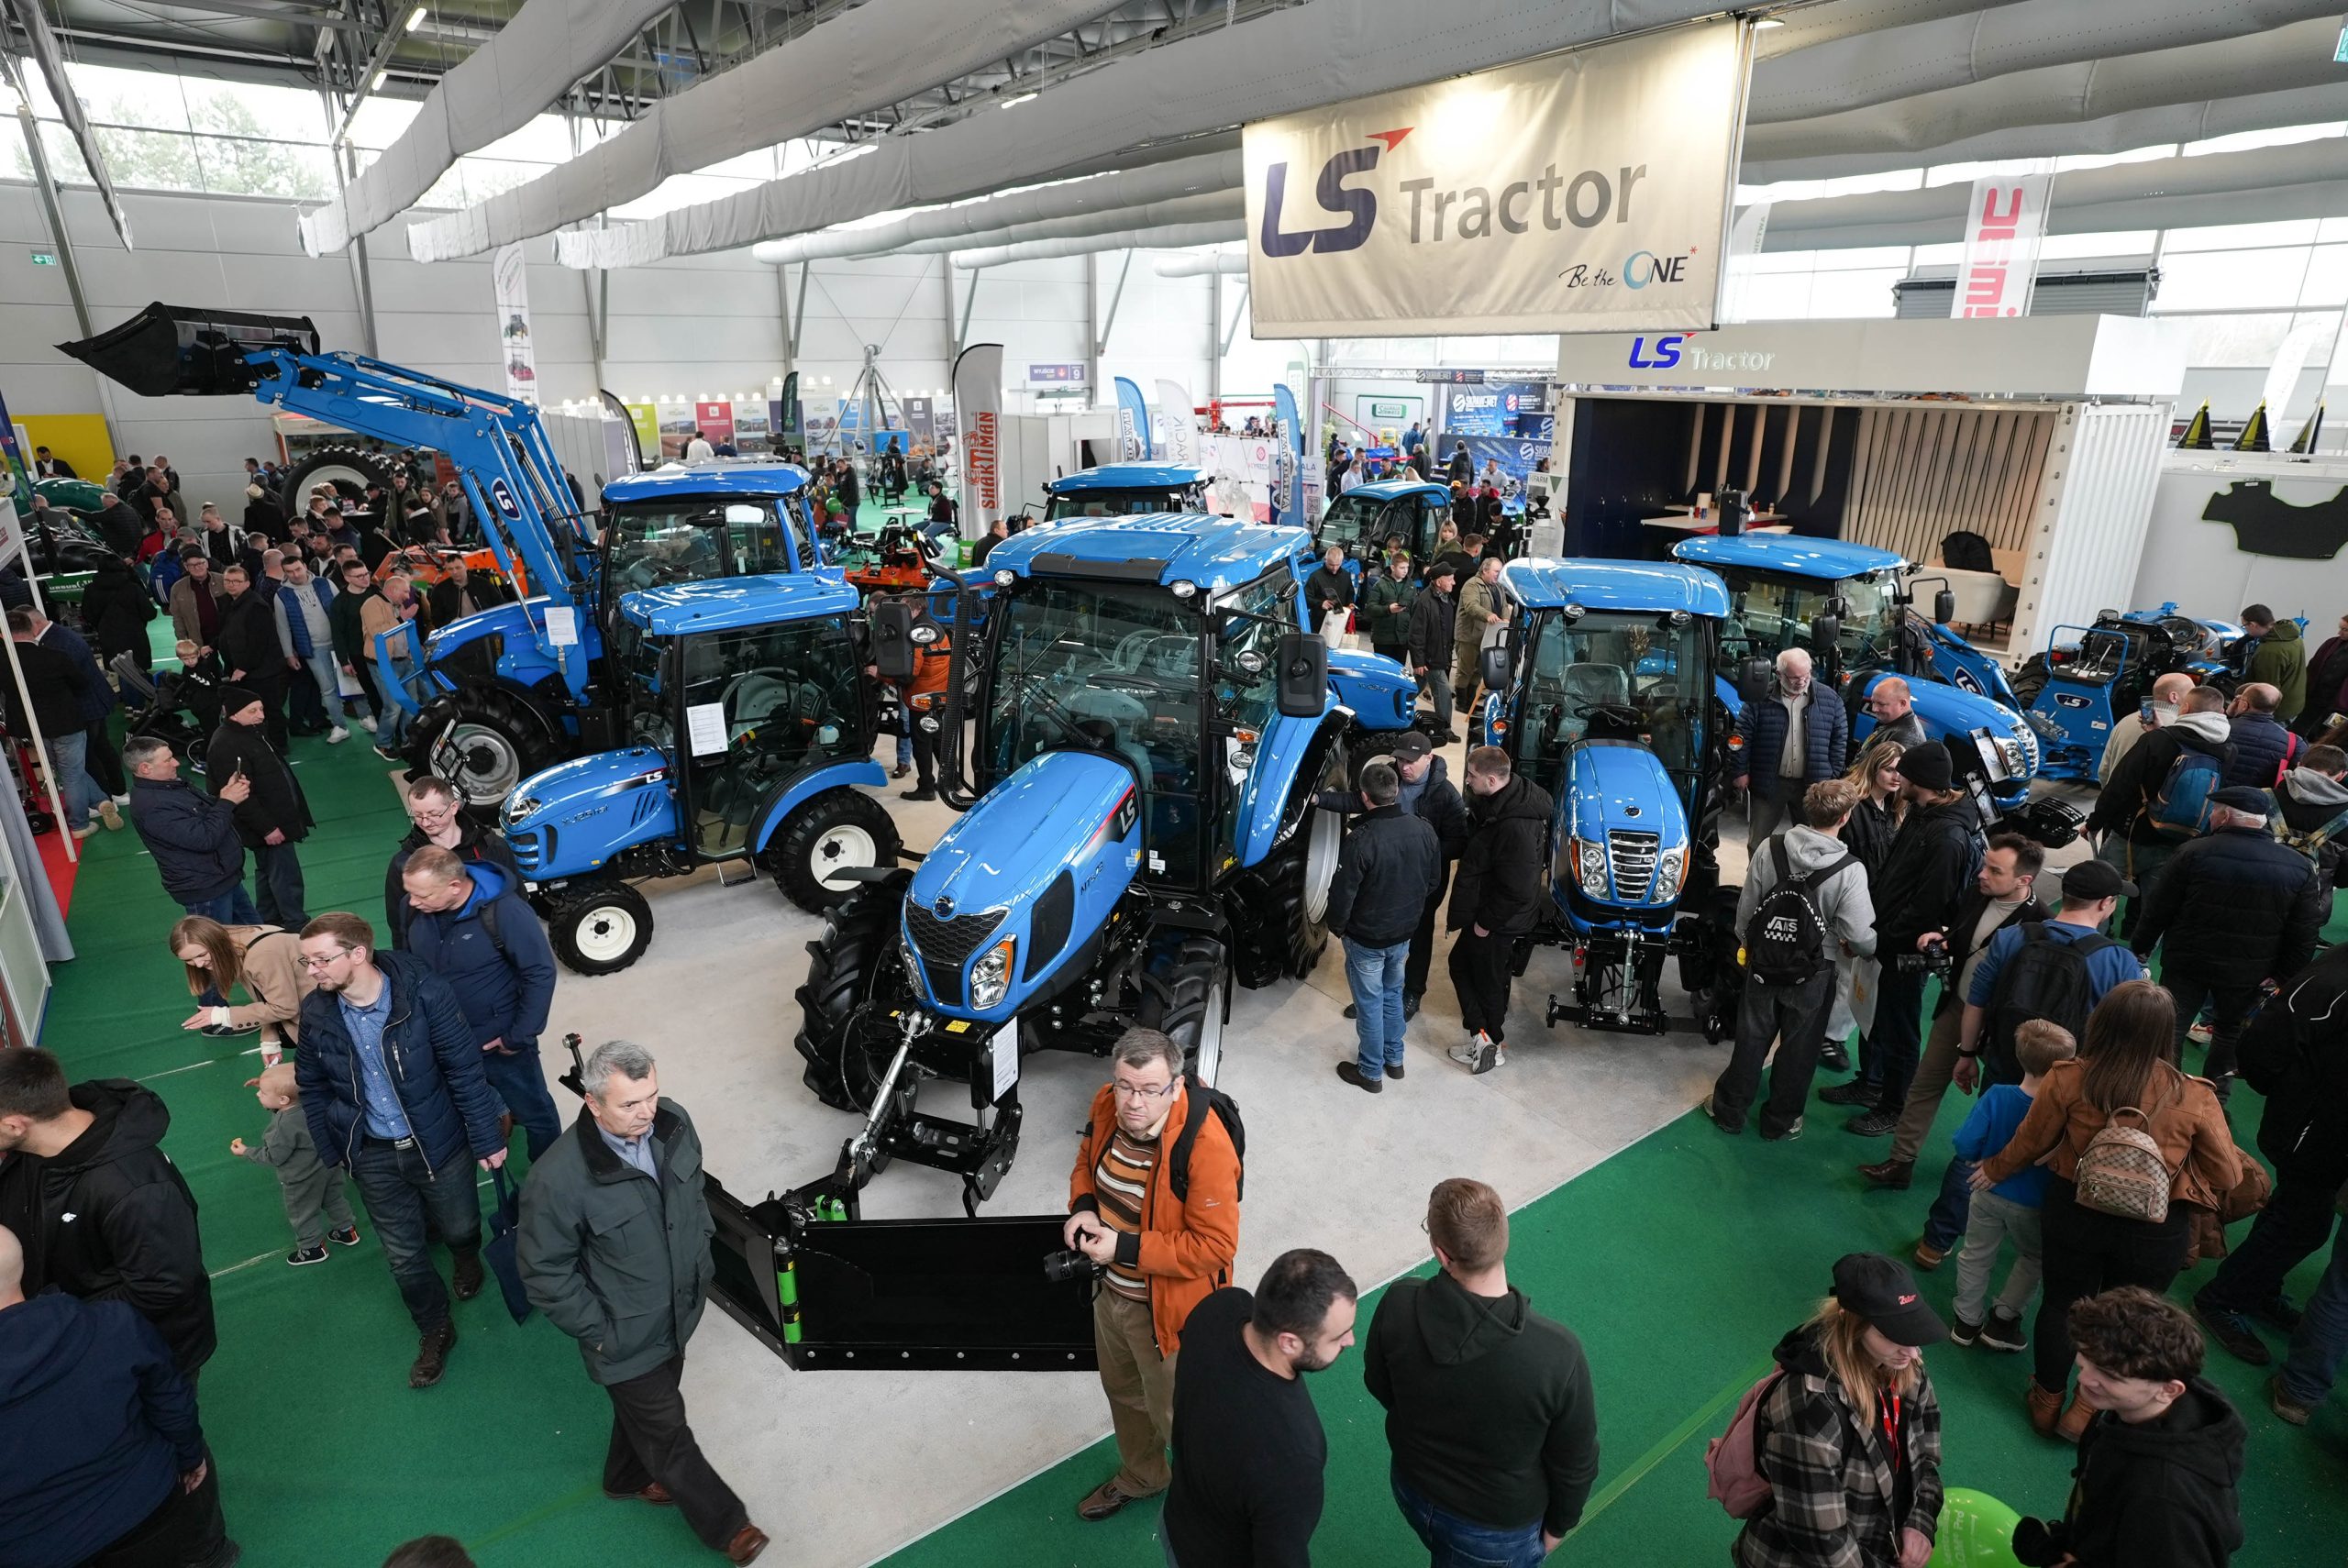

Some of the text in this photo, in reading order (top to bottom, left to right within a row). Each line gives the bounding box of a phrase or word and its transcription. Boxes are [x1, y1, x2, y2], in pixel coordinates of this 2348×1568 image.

[1260, 145, 1647, 258] LS Tractor
[1559, 249, 1689, 290] Be the ONE
[1628, 337, 1775, 370] LS Tractor
[1073, 369, 1080, 380] 9
[970, 411, 995, 510] SHAKTIMAN
[495, 490, 514, 511] LS
[2064, 697, 2081, 707] LS
[646, 771, 663, 784] LS
[1120, 798, 1135, 834] LS
